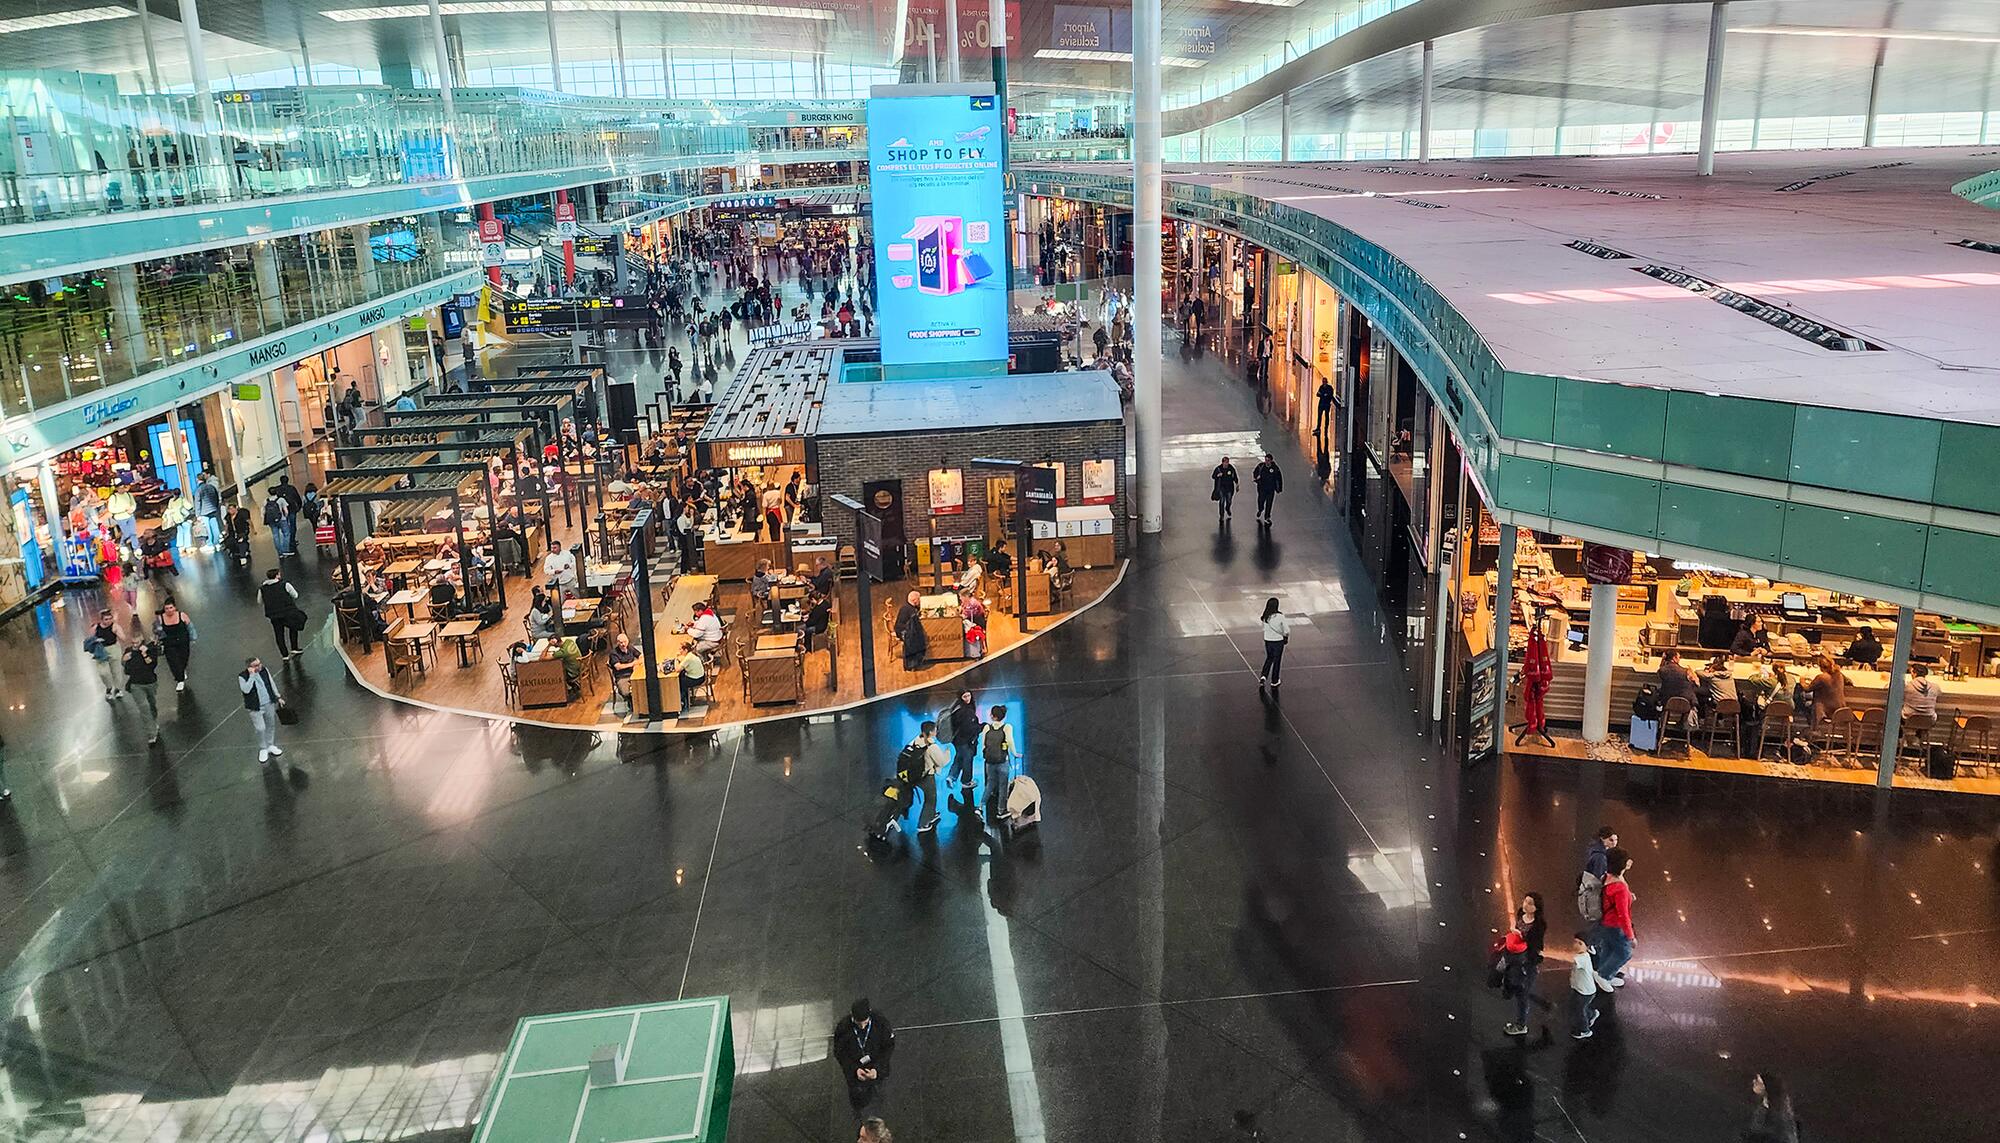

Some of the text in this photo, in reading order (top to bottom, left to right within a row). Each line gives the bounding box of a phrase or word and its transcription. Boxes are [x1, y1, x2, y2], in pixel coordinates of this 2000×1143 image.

[801, 113, 854, 122] BURGER KING
[888, 147, 985, 161] SHOP TO FLY
[974, 161, 998, 169] ONLINE
[359, 306, 386, 327] MANGO
[928, 330, 961, 338] SHOPPING
[249, 341, 287, 367] MANGO
[95, 396, 138, 419] Hudson
[728, 443, 783, 460] SANTAMARÍA
